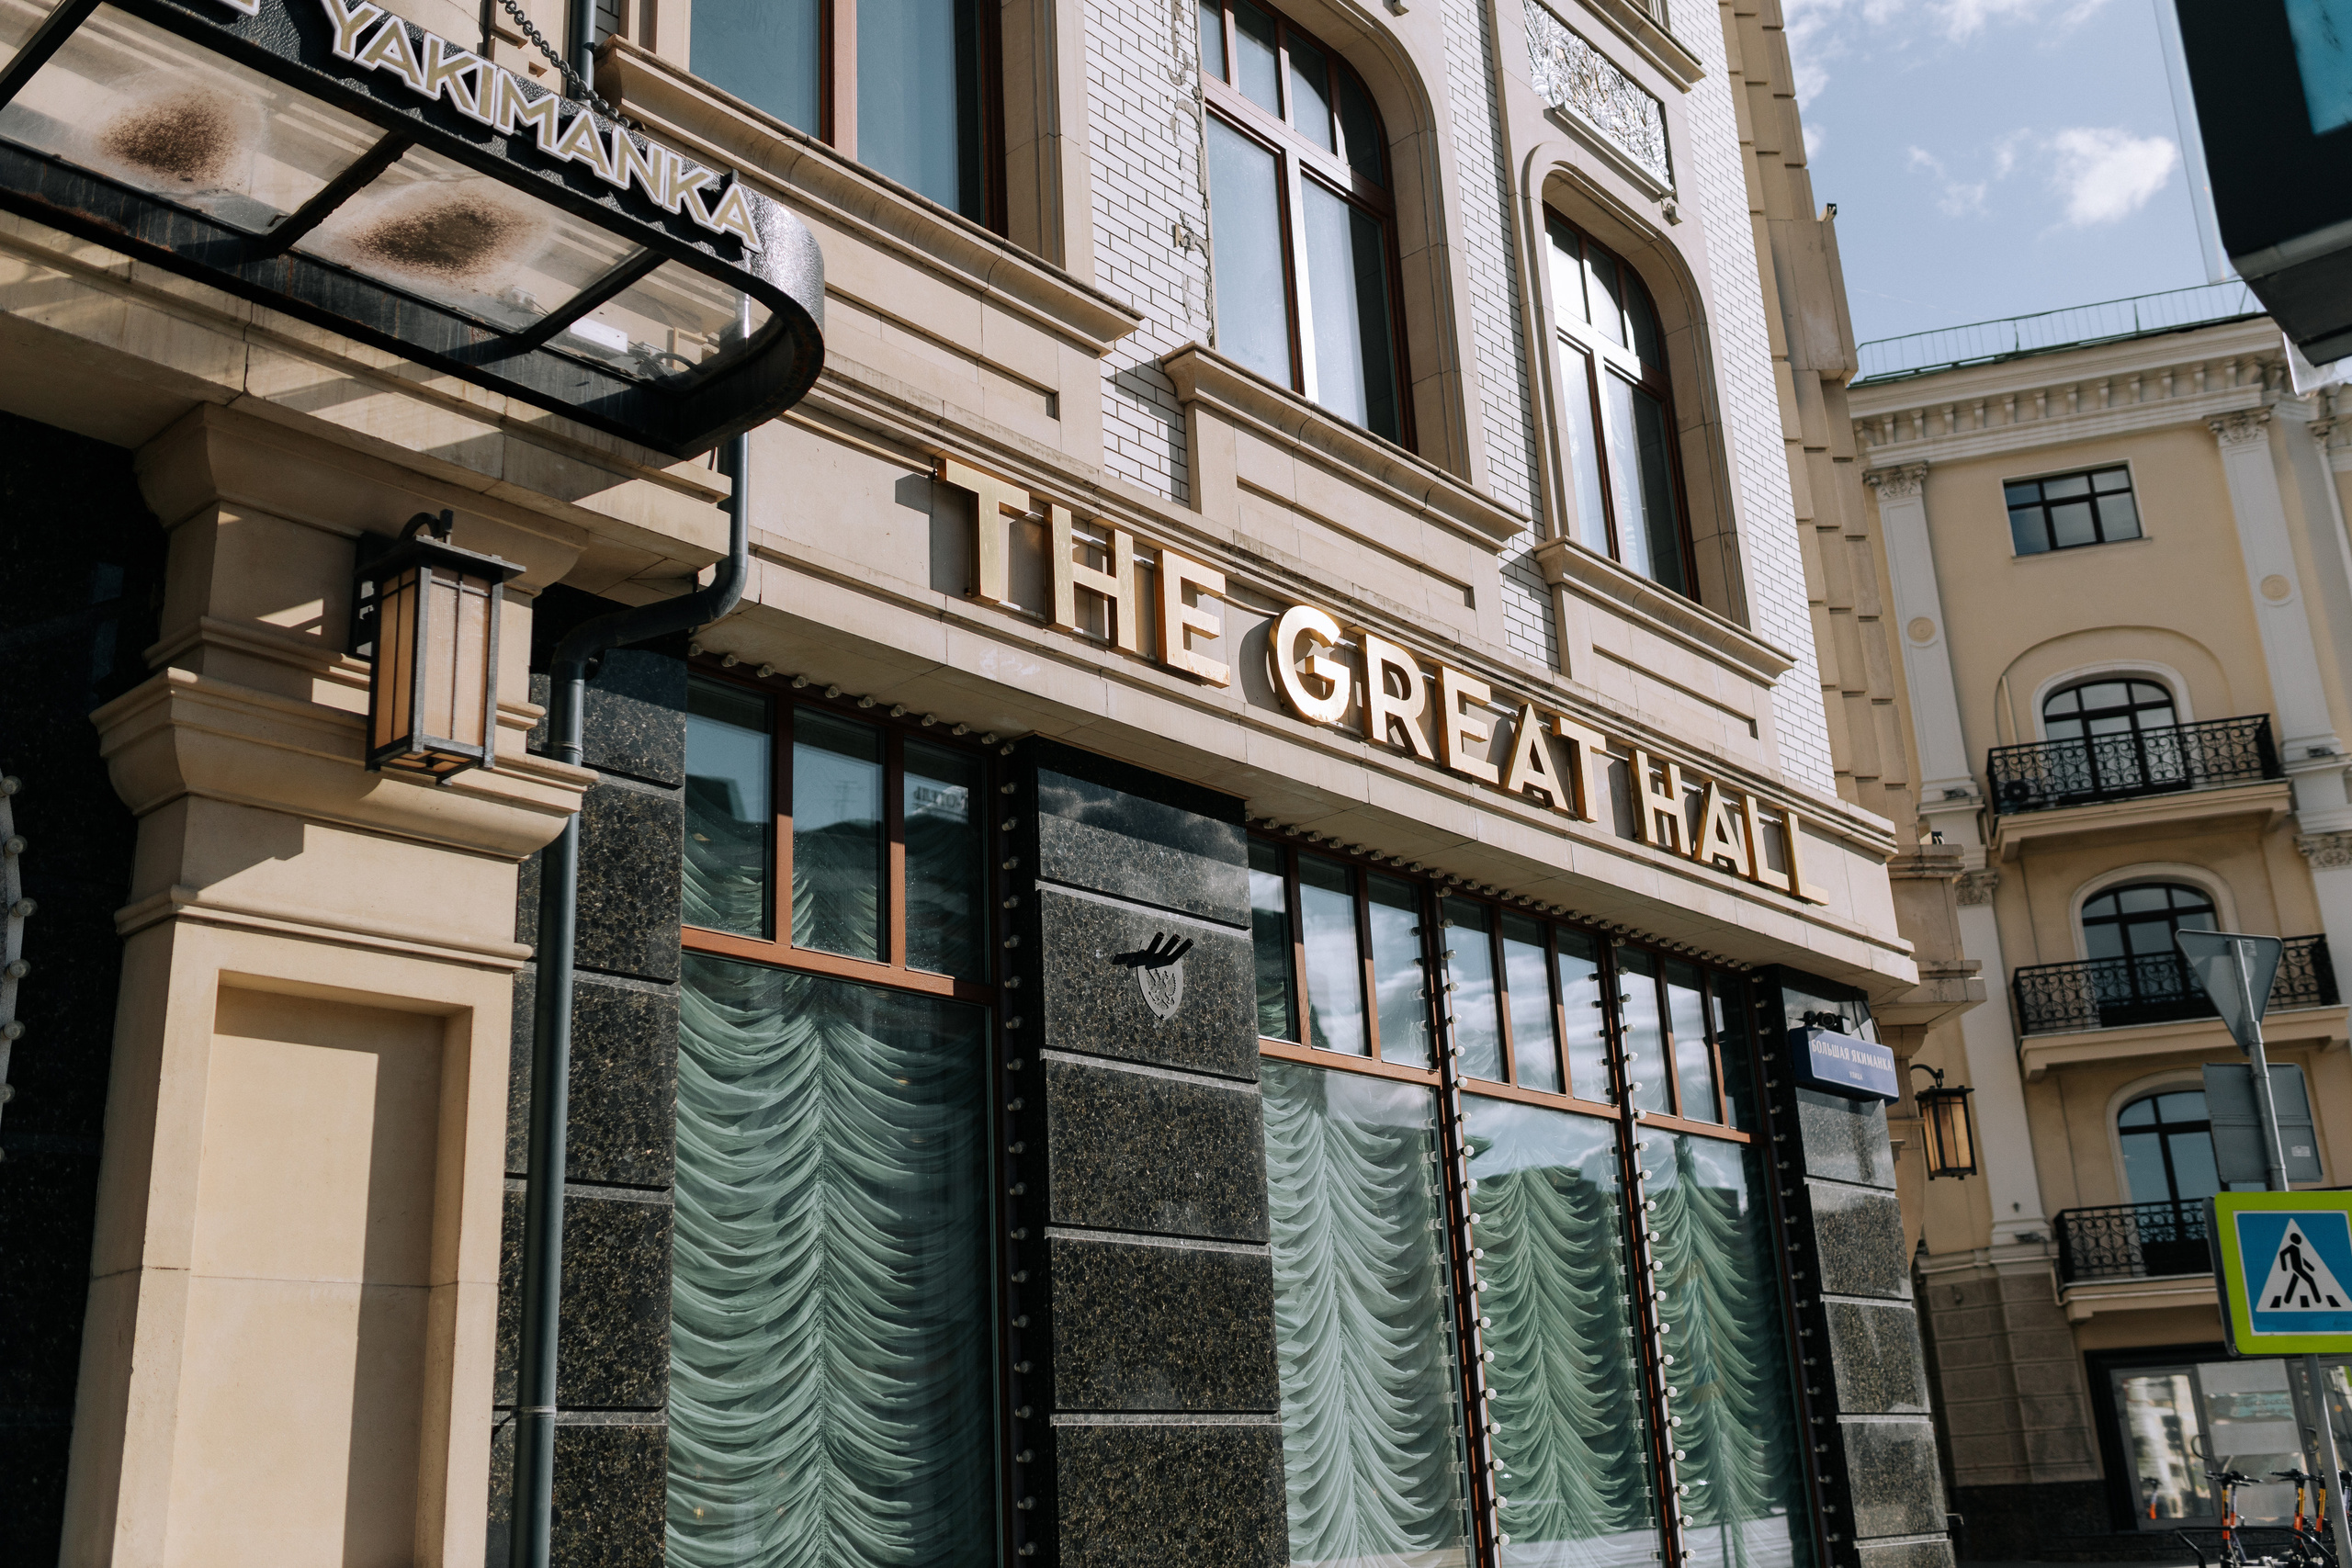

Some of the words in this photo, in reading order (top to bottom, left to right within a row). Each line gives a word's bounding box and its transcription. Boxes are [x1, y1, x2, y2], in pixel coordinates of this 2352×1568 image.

[320, 0, 763, 254] YAKIMANKA
[936, 458, 1230, 688] THE
[1268, 604, 1607, 823] GREAT
[1627, 749, 1829, 906] HALL
[1811, 1039, 1850, 1061] БОЛЬШАЯ
[1850, 1049, 1894, 1072] ЯКИМАНКА
